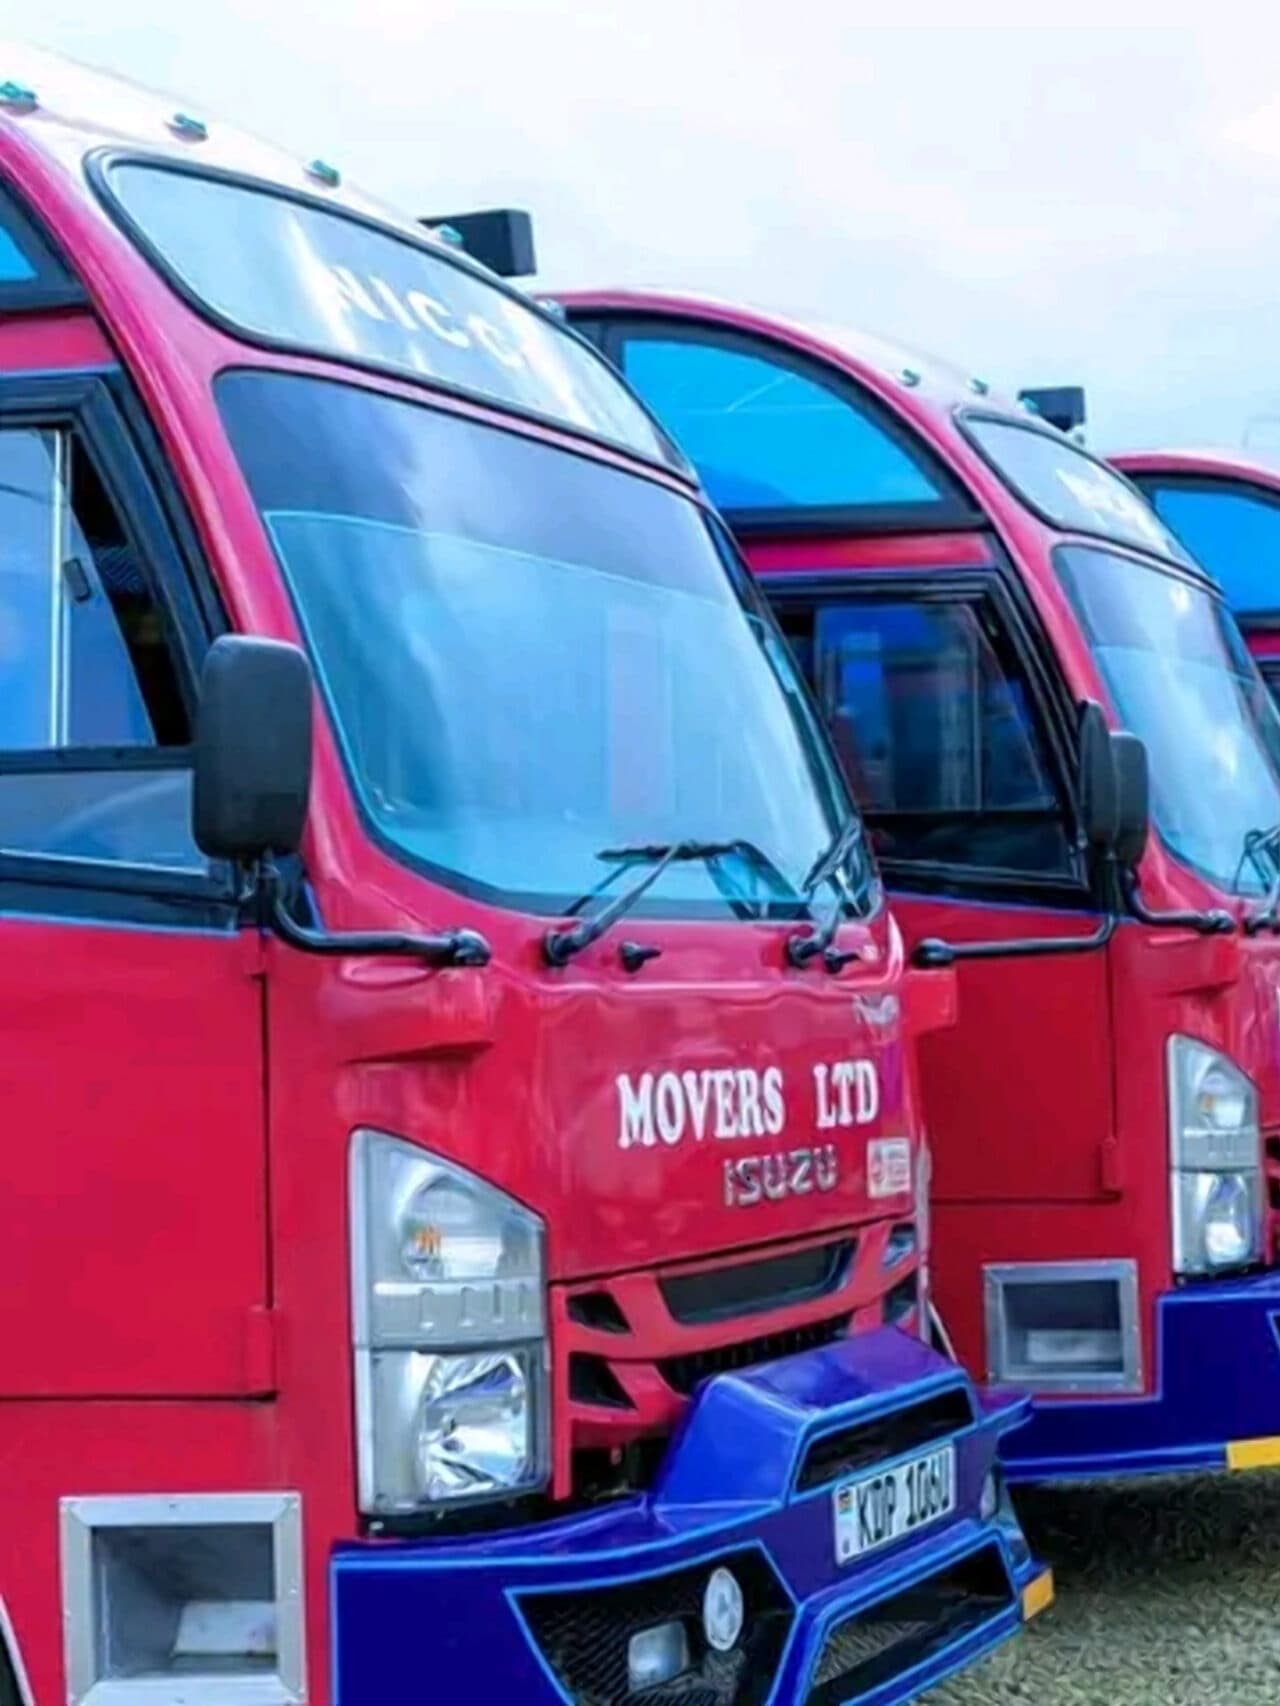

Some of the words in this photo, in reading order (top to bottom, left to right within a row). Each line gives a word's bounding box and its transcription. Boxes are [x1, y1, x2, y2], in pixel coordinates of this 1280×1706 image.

[616, 1066, 786, 1149] MOVERS
[813, 1059, 879, 1129] LTD
[723, 1145, 838, 1206] ISUZU
